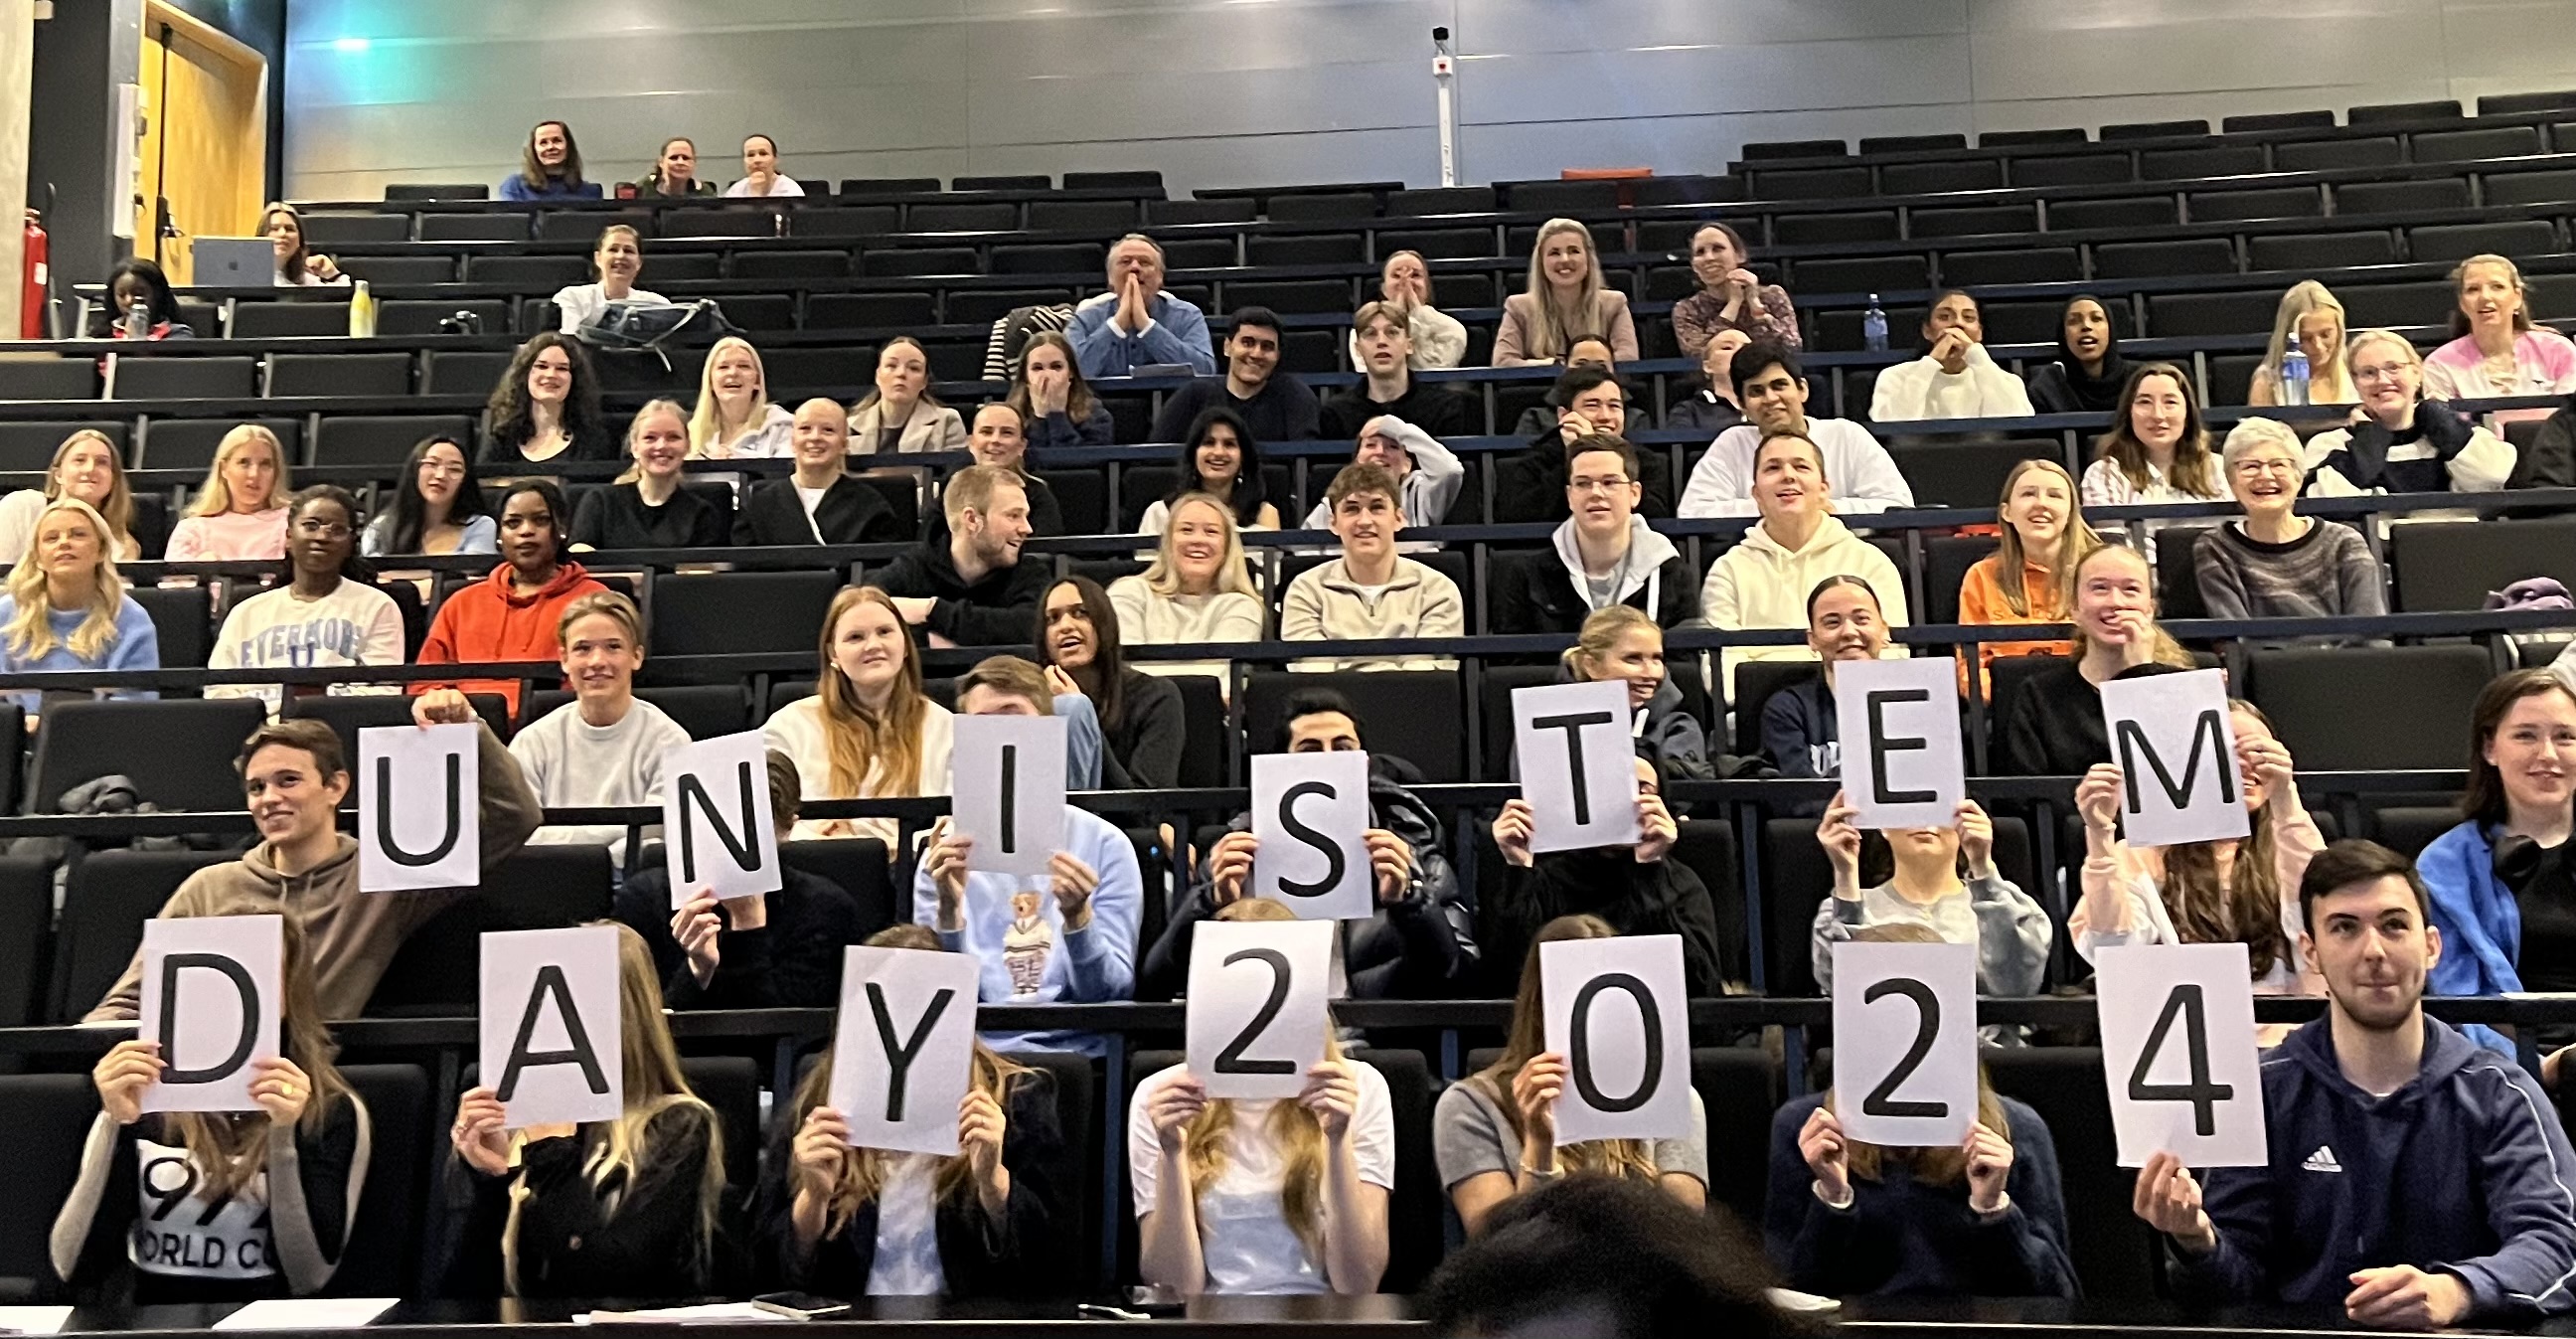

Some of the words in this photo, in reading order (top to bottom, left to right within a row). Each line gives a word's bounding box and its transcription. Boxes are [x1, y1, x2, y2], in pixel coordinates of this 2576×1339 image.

[1001, 746, 1015, 853] I
[1532, 712, 1612, 825] T
[1867, 690, 1937, 804] E
[2117, 710, 2235, 813] M
[378, 753, 460, 866] U
[679, 761, 761, 883] N
[1278, 782, 1345, 897] S
[157, 953, 259, 1084] D
[494, 966, 609, 1102] A
[866, 983, 954, 1121] Y
[1214, 949, 1296, 1075] 2
[1570, 973, 1663, 1112] 0
[1863, 978, 1948, 1117] 2
[2129, 985, 2233, 1136] 4
